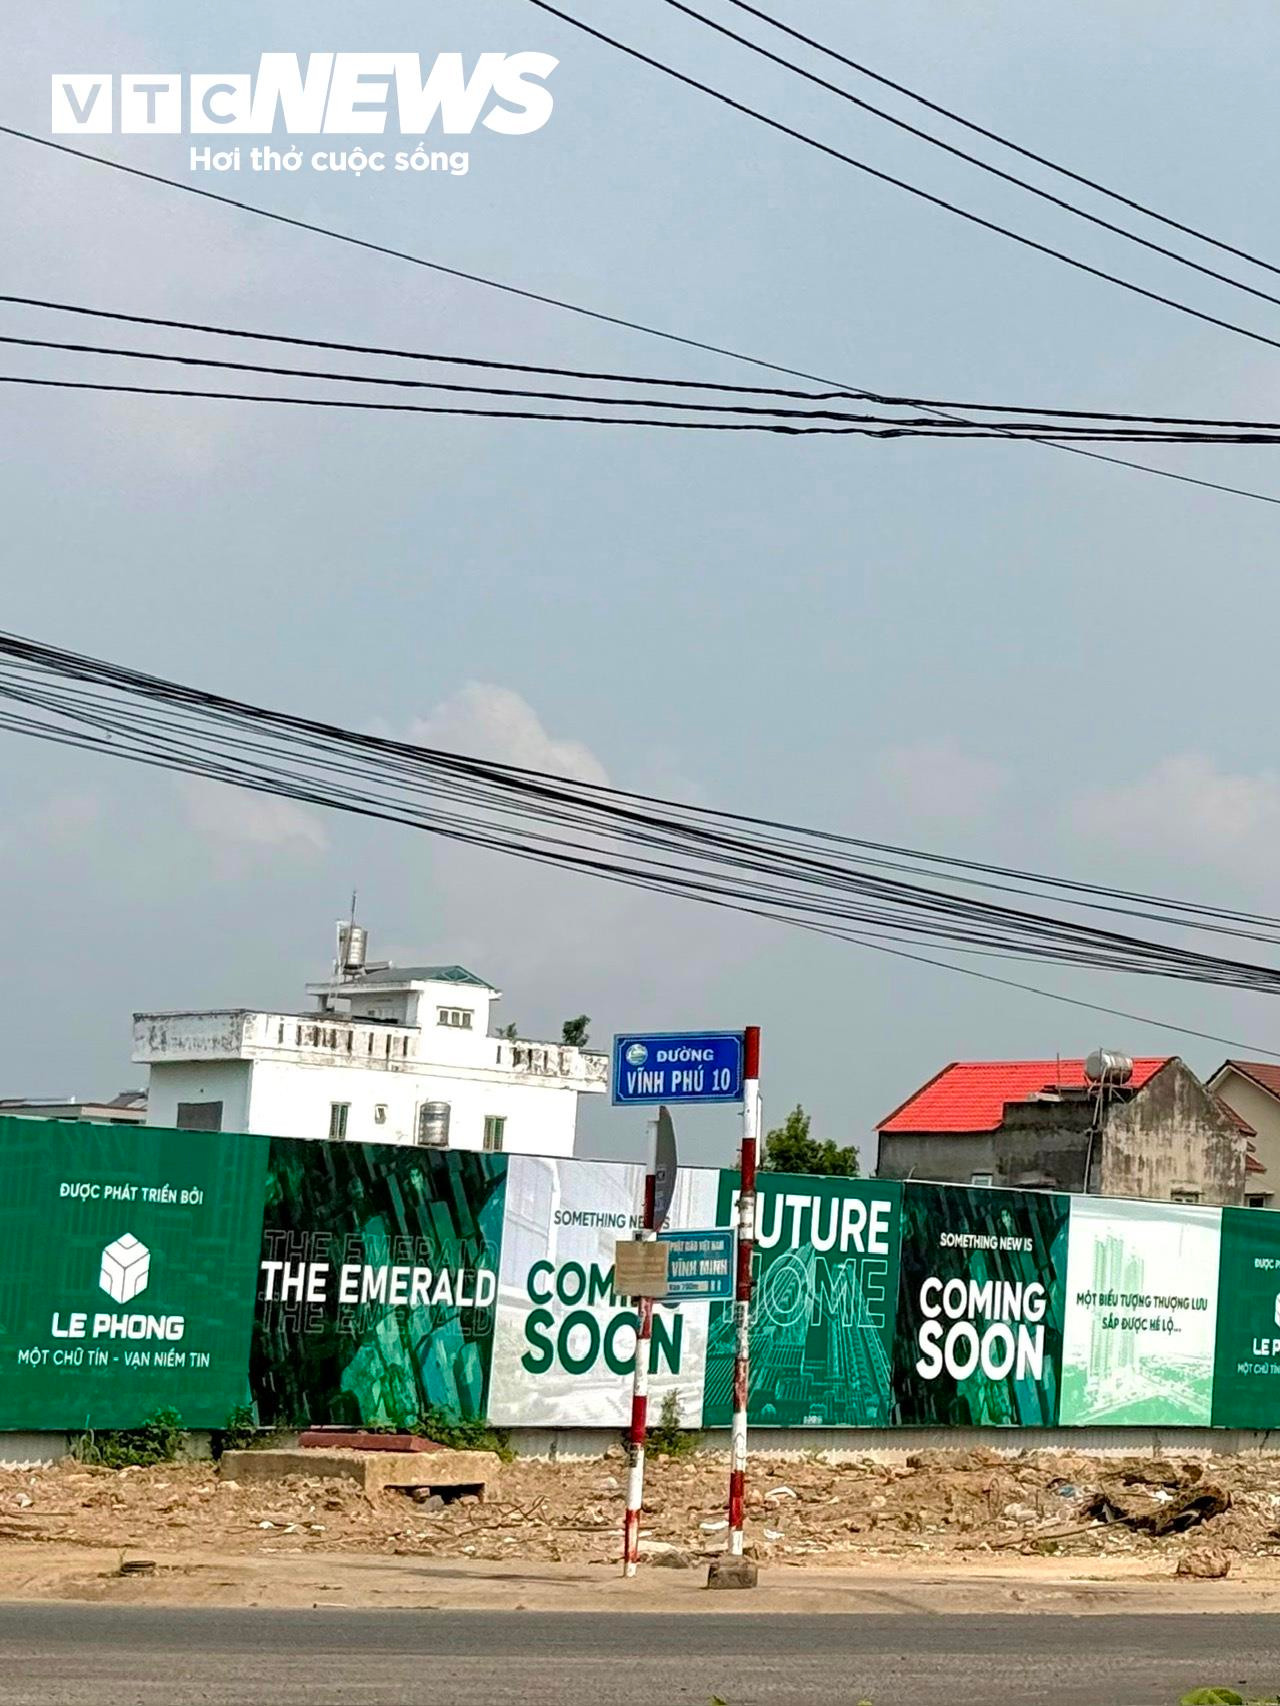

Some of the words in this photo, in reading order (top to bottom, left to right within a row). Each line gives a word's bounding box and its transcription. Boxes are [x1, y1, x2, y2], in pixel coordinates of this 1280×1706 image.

[656, 1045, 714, 1063] ĐƯỜNG
[627, 1067, 664, 1094] VĨNH
[671, 1065, 704, 1093] PHÚ
[712, 1068, 731, 1091] 10
[60, 1183, 100, 1202] ĐƯỢC
[104, 1183, 138, 1200] PHÁT
[181, 1186, 204, 1205] BỞI
[554, 1210, 626, 1229] SOMETHING
[940, 1232, 998, 1250] SOMETHING
[999, 1236, 1023, 1251] NEW
[1024, 1238, 1033, 1252] IS
[260, 1261, 330, 1303] THE
[338, 1263, 496, 1307] EMERALD
[526, 1259, 681, 1309] COM
[920, 1276, 1047, 1322] COMING
[1076, 1289, 1097, 1310] MỘT
[1120, 1293, 1152, 1311] TƯỢNG
[51, 1312, 88, 1338] LE
[92, 1313, 185, 1340] PHONG
[1121, 1316, 1148, 1334] ĐƯỢC
[521, 1308, 683, 1376] SOON
[916, 1319, 1045, 1381] SOON
[1253, 1338, 1270, 1356] LE
[18, 1347, 49, 1368] MỘT
[53, 1347, 83, 1366] CHỮ
[88, 1347, 108, 1366] TÍN
[124, 1351, 150, 1370] VẠN
[190, 1352, 210, 1368] TIN
